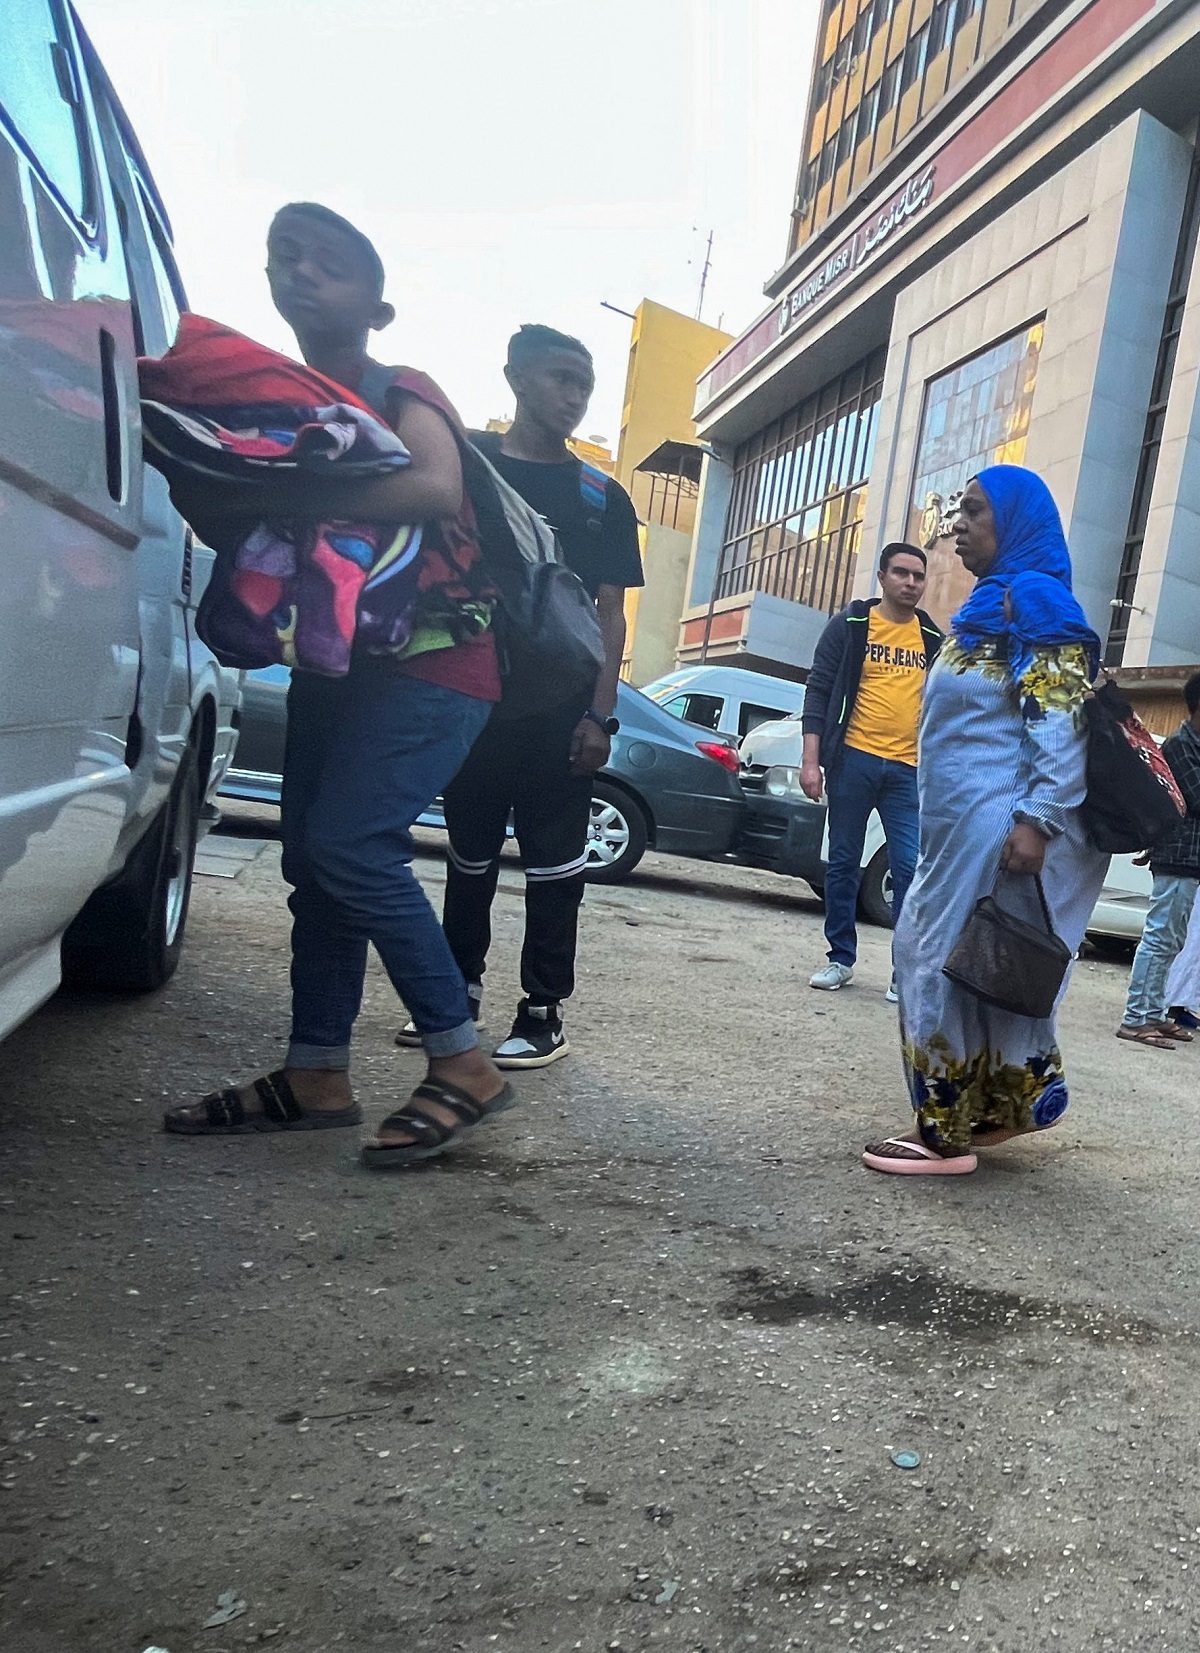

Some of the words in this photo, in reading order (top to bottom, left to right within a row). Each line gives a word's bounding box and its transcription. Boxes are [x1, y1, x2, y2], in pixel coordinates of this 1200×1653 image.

[791, 271, 825, 316] BANQUE
[824, 249, 849, 285] MISR
[865, 643, 890, 664] PEPE
[892, 647, 926, 670] JEANS
